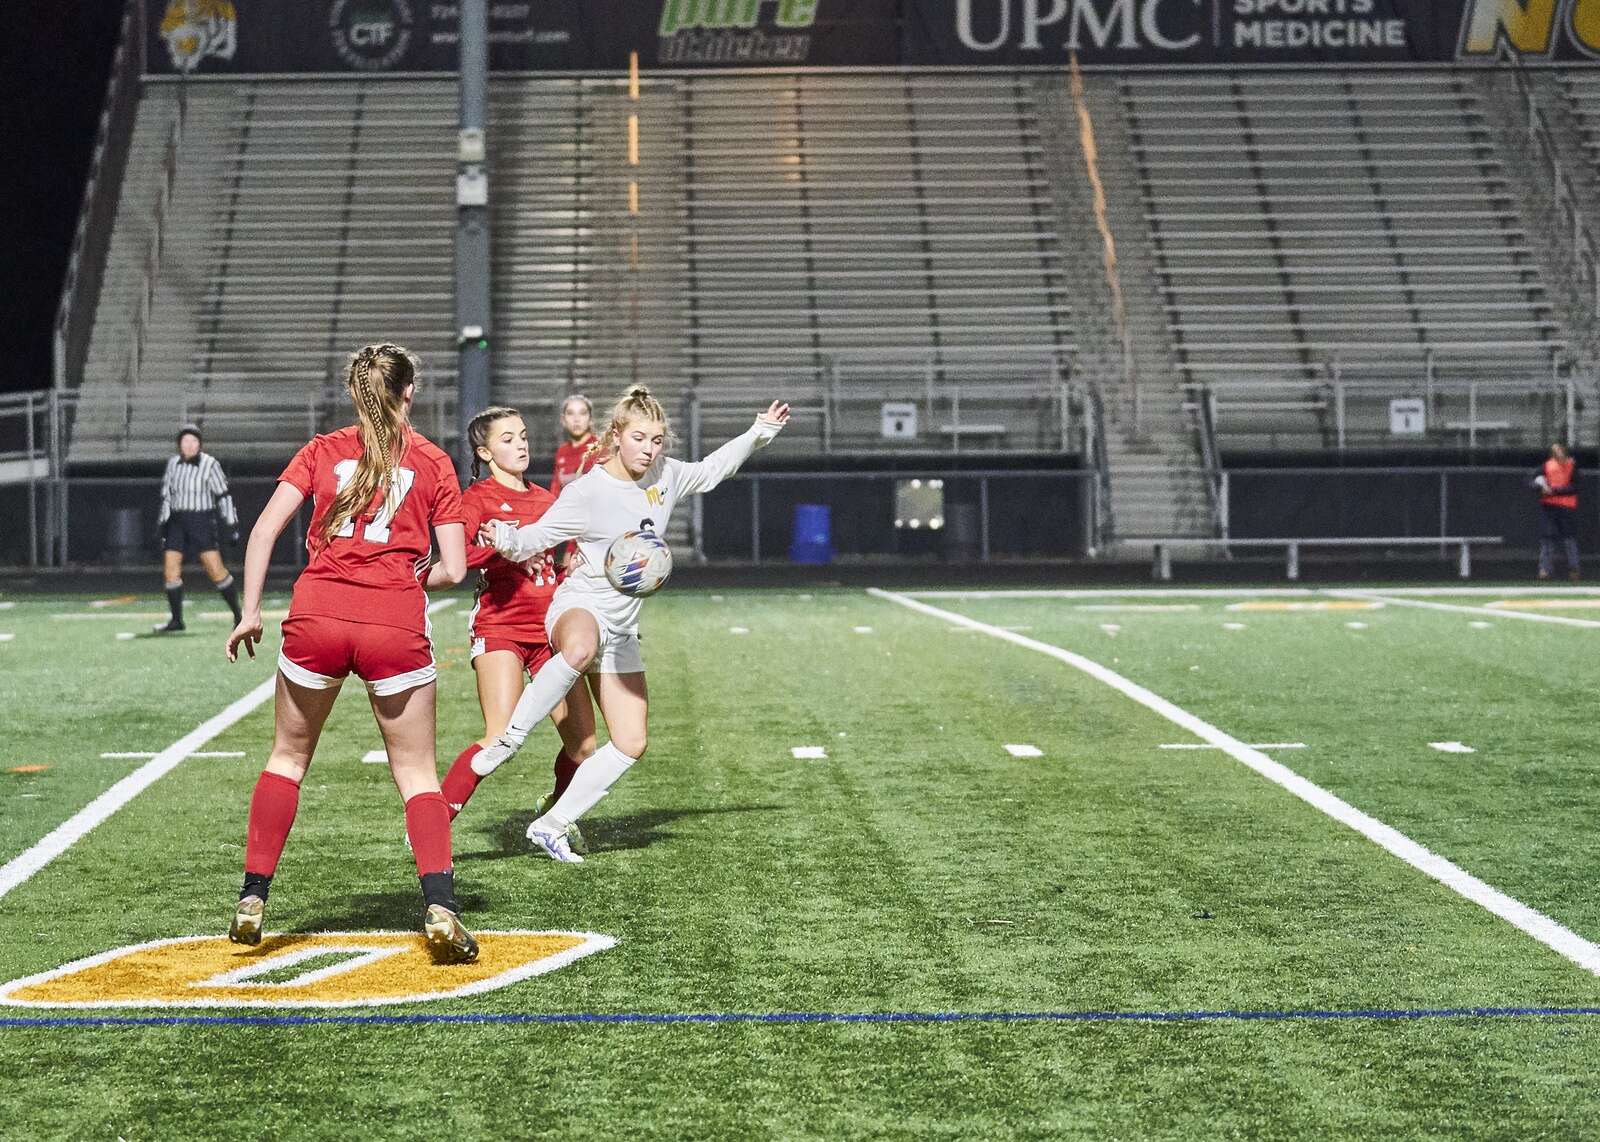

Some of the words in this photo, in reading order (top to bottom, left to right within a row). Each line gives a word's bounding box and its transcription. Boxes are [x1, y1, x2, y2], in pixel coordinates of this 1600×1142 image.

[956, 0, 1201, 50] UPMC
[1233, 20, 1406, 48] MEDICINE
[334, 458, 416, 544] 17
